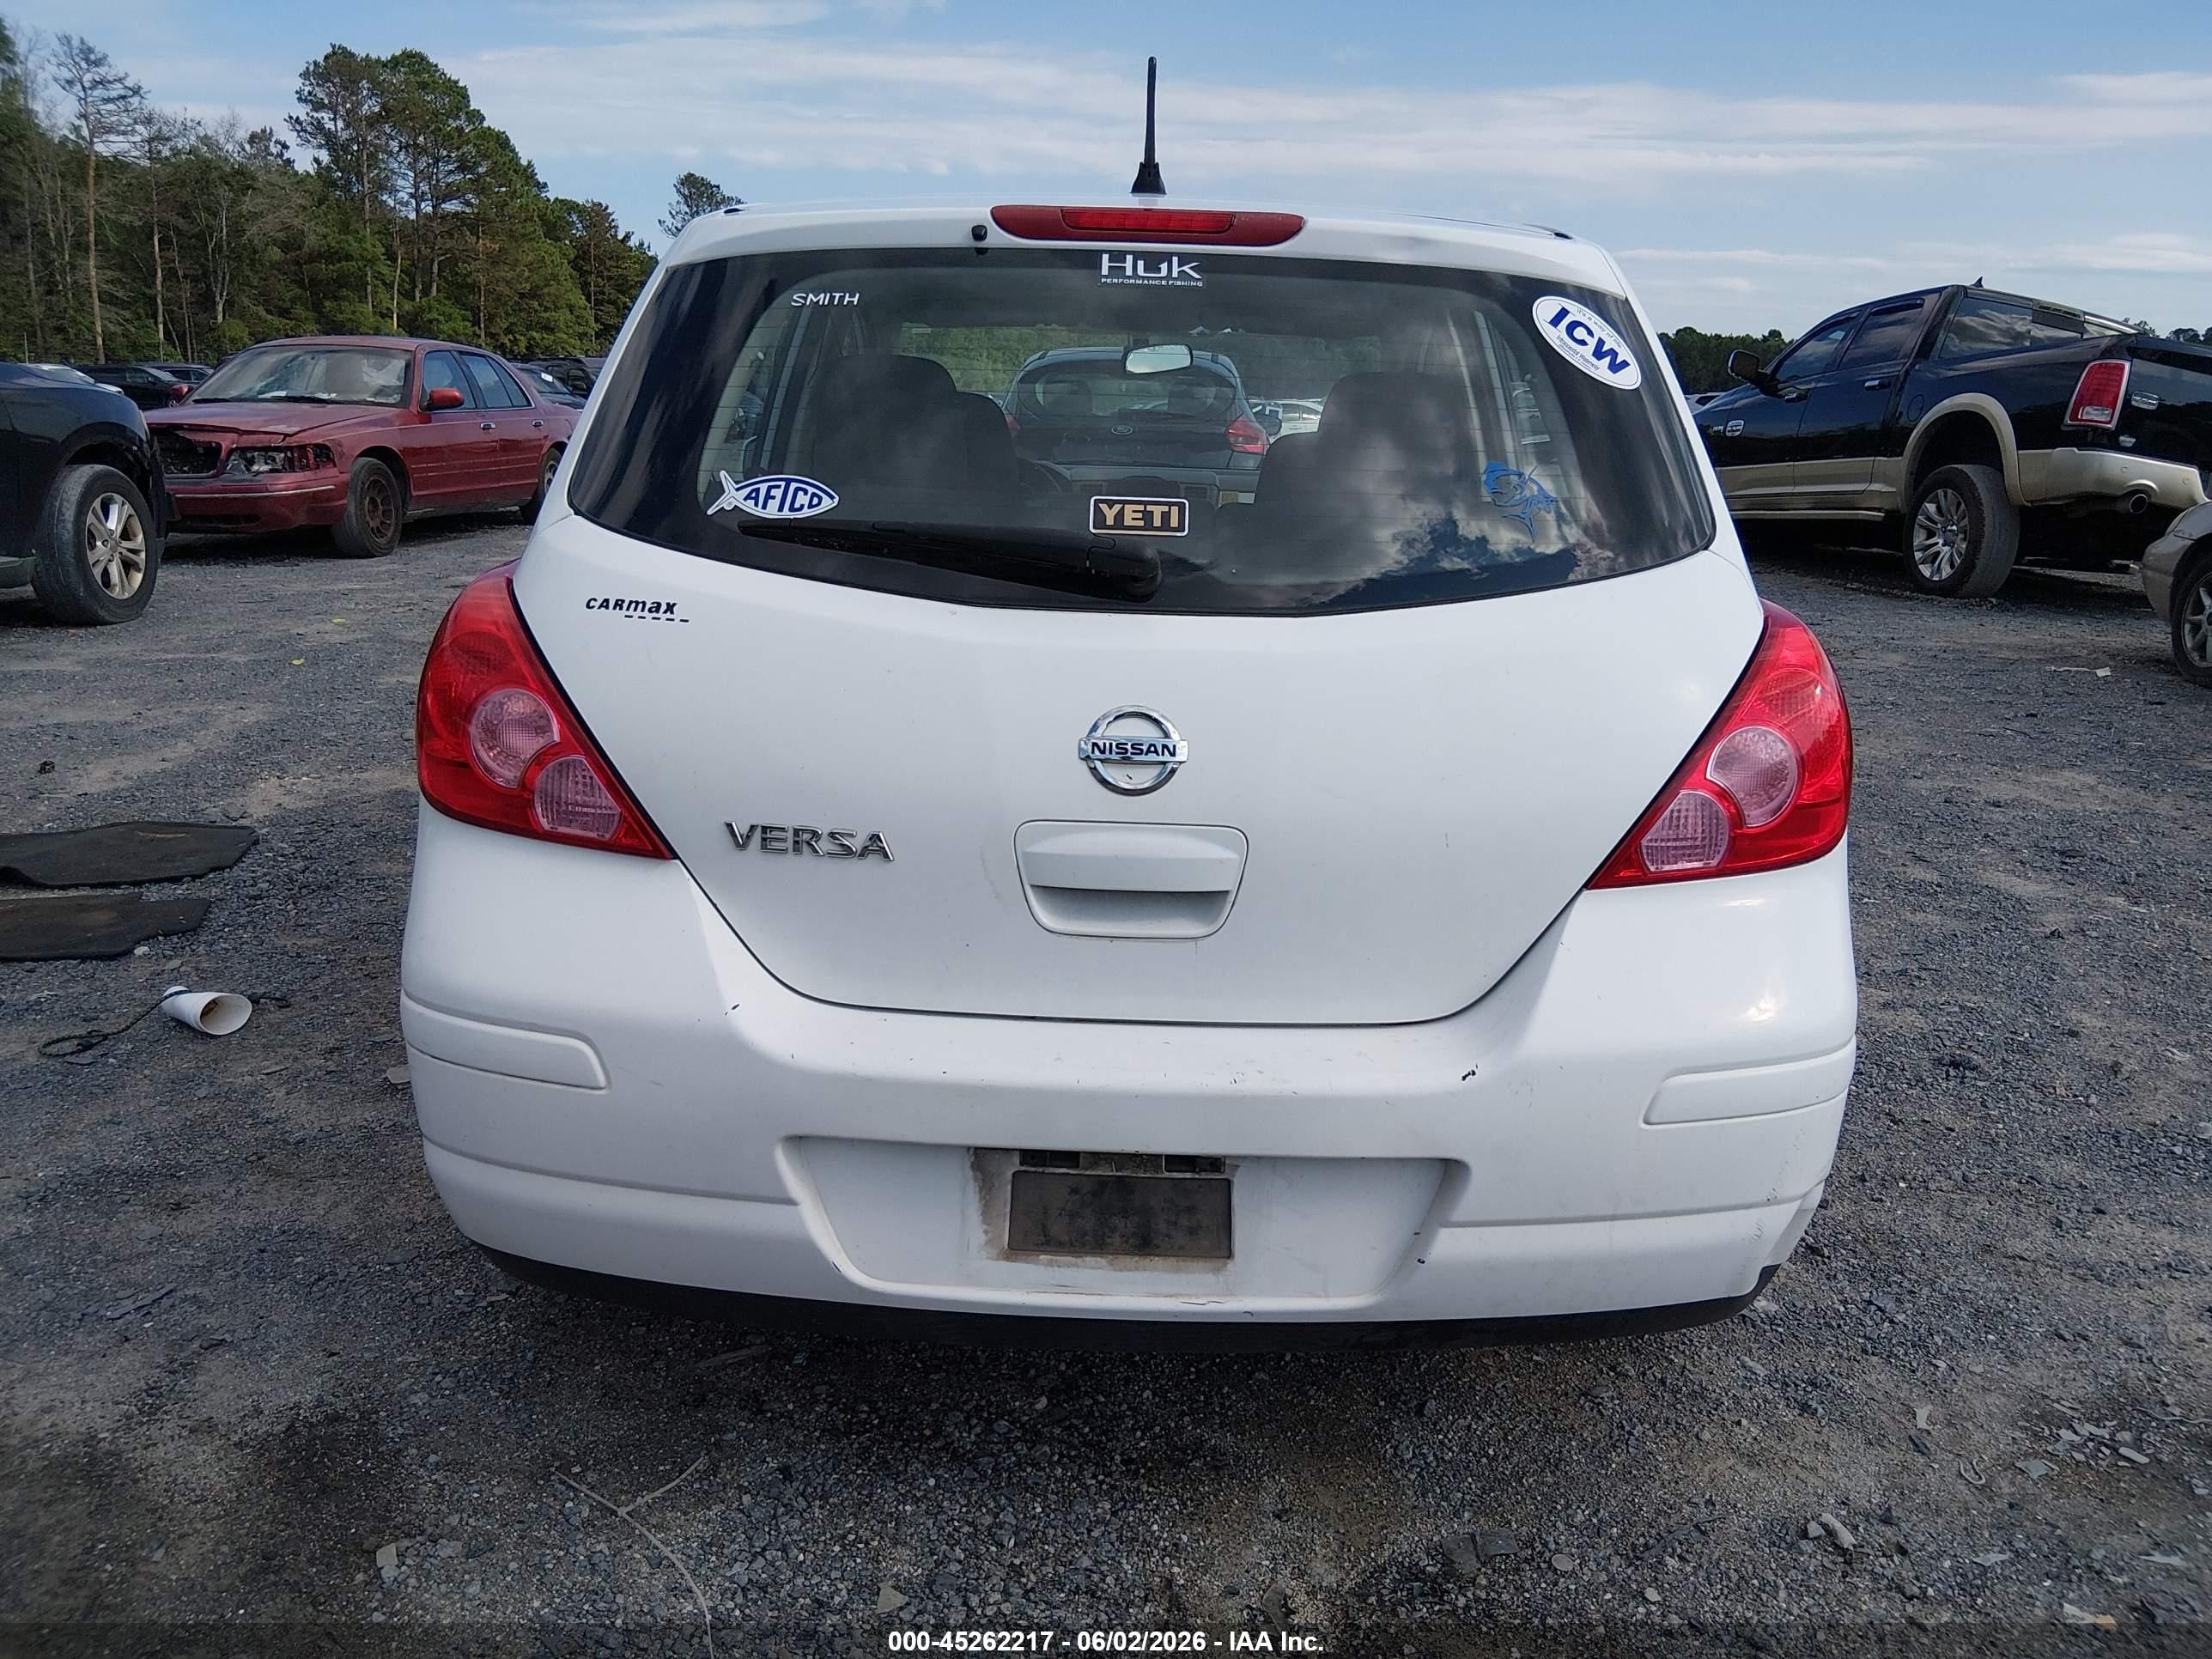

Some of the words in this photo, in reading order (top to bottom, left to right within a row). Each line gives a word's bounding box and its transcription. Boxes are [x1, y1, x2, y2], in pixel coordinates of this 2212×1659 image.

[1101, 253, 1202, 279] Huk
[791, 293, 860, 307] SMITH
[1543, 302, 1631, 374] ICW
[1593, 320, 1606, 332] way
[740, 477, 827, 513] AFTCO
[1099, 503, 1179, 527] YETI
[1091, 741, 1176, 757] NISSAN
[724, 821, 894, 861] VERSA
